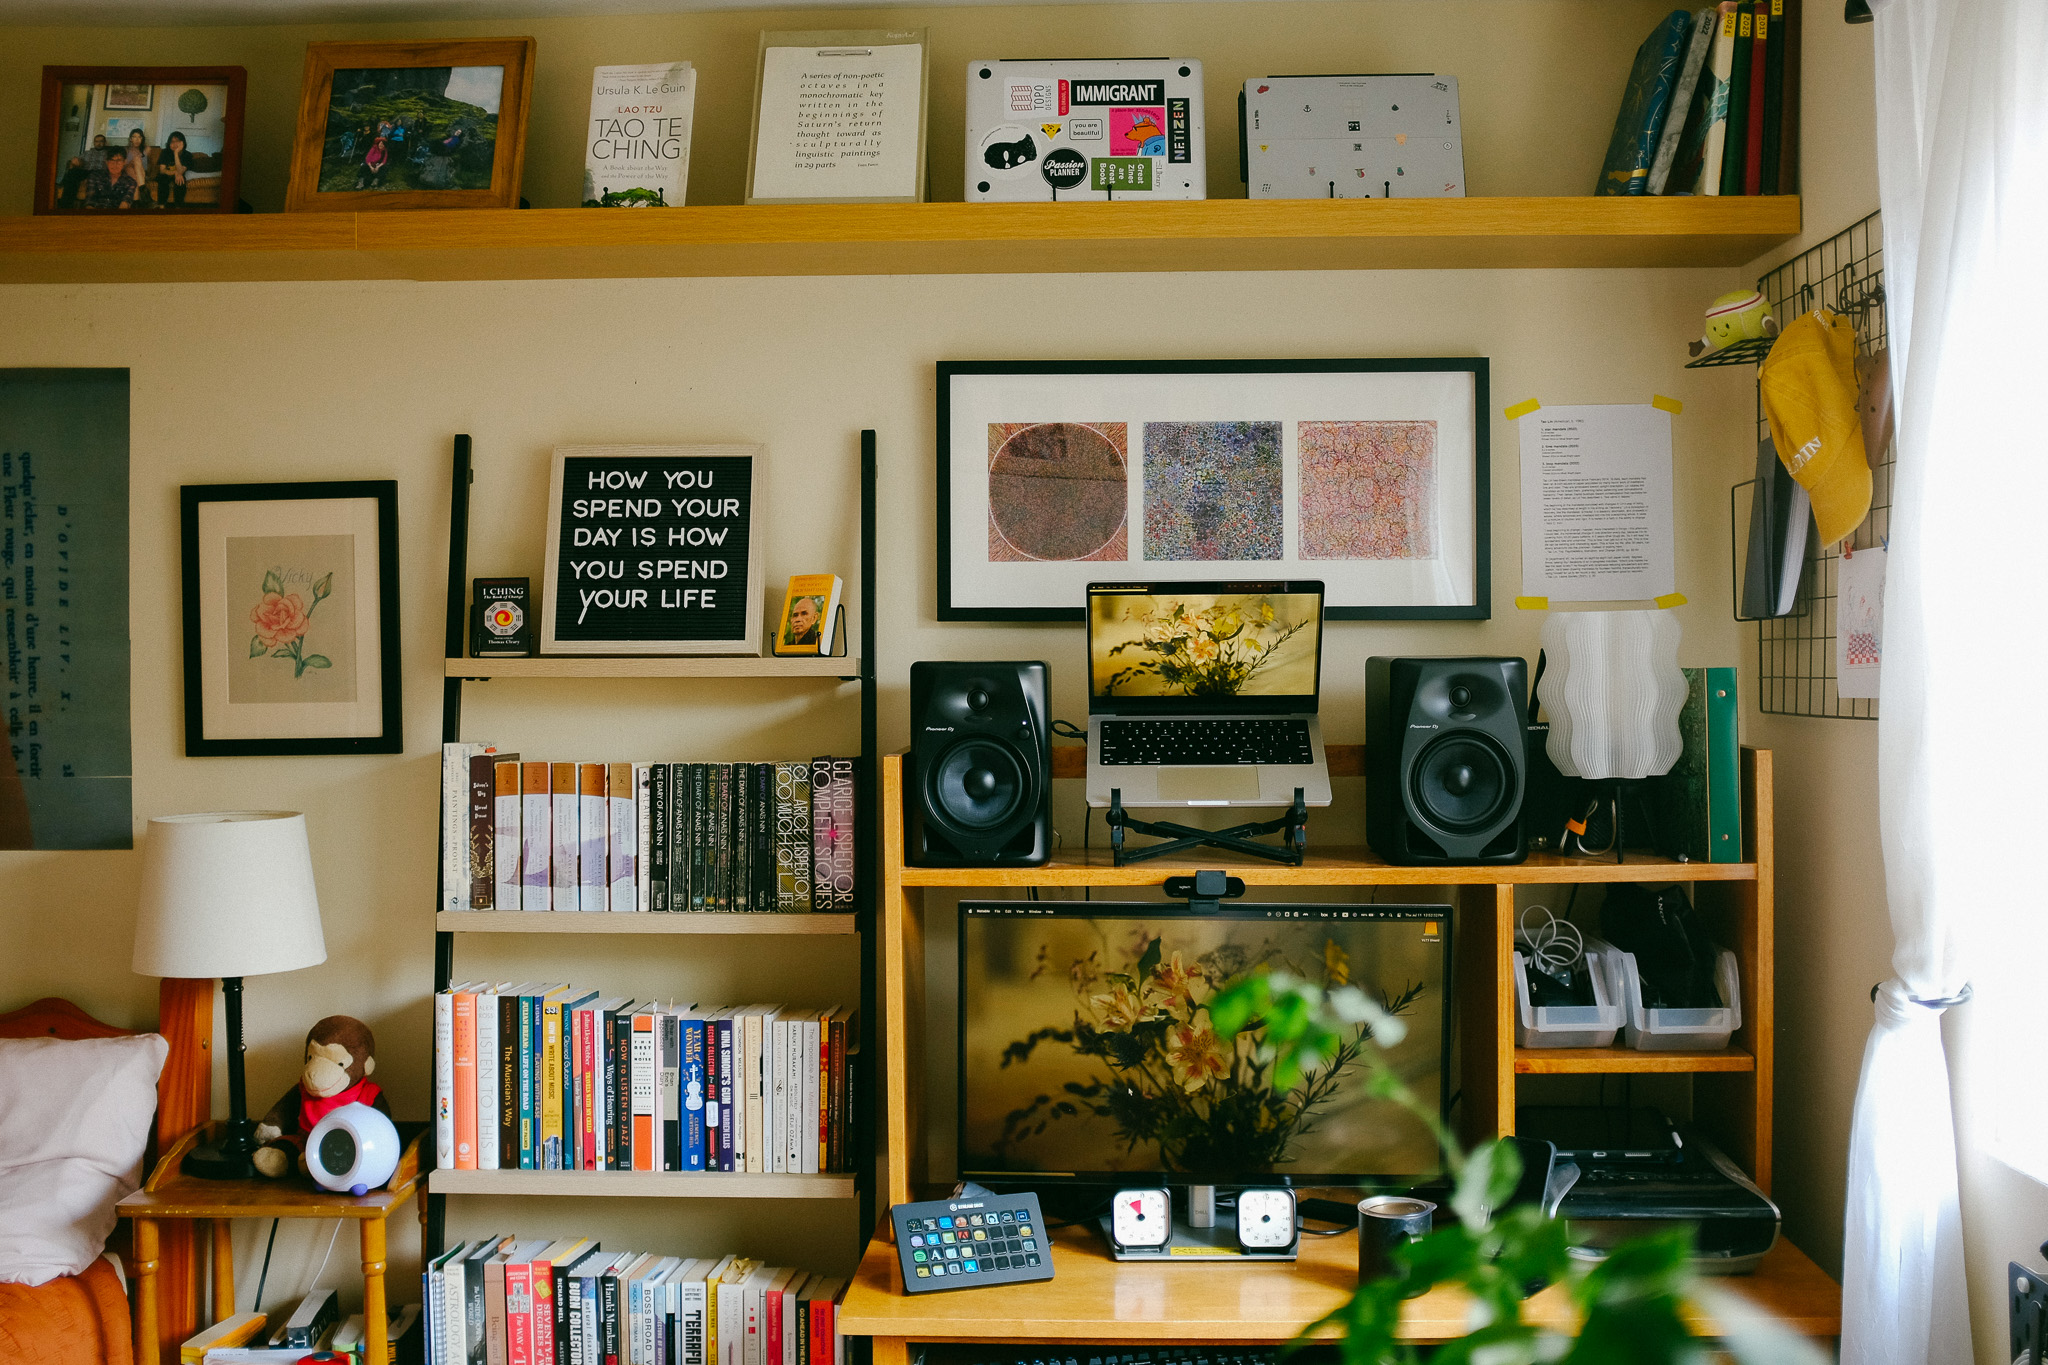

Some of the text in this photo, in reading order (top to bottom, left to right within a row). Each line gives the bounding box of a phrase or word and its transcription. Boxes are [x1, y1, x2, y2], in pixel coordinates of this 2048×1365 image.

[1702, 16, 1712, 35] 2022
[1725, 14, 1733, 34] 2021
[833, 72, 842, 80] of
[843, 72, 884, 80] non-poetic
[597, 84, 685, 95] Ursula K. Le Guin
[1034, 85, 1044, 110] TOPO
[1077, 85, 1157, 101] IMMIGRANT
[618, 106, 639, 114] LAO
[798, 112, 864, 120] beginnings
[595, 118, 682, 138] TAO TE
[797, 131, 829, 139] thought
[1173, 101, 1185, 160] NETIZEN
[592, 138, 680, 159] CHING
[796, 140, 881, 149] sculpturally
[796, 150, 880, 159] linguistic paintings
[1044, 160, 1084, 170] Passion
[1050, 168, 1080, 176] PLANNER
[588, 470, 713, 490] HOW YOU
[573, 498, 739, 518] SPEND YOUR
[574, 527, 728, 547] DAY IS HOW
[570, 560, 728, 580] YOU SPEND
[24, 566, 37, 606] moins
[578, 589, 716, 625] YOUR LIFE
[25, 613, 40, 650] d'une
[28, 704, 40, 713] il
[657, 800, 663, 809] OF
[777, 766, 794, 907] TOO MUCH OF LIFE
[793, 766, 809, 901] CLARICE LISPECTOR
[813, 761, 832, 909] COMPLETE STORIES
[833, 761, 853, 902] CLARICE LISPECTOR
[685, 1027, 693, 1063] WONDER
[694, 1054, 701, 1062] of
[721, 1030, 731, 1104] NINA SIMONE'S GUM
[621, 1065, 626, 1074] TO
[479, 1028, 493, 1148] LISTEN TO THIS
[606, 1064, 614, 1125] Ways of Hearing
[503, 1108, 512, 1127] Way
[622, 1112, 627, 1121] TO
[722, 1109, 730, 1133] WARREN
[569, 1282, 580, 1309] BURN
[605, 1283, 616, 1354] Haruki Murakami
[491, 1316, 500, 1358] Being and
[536, 1304, 544, 1356] DEGREES of
